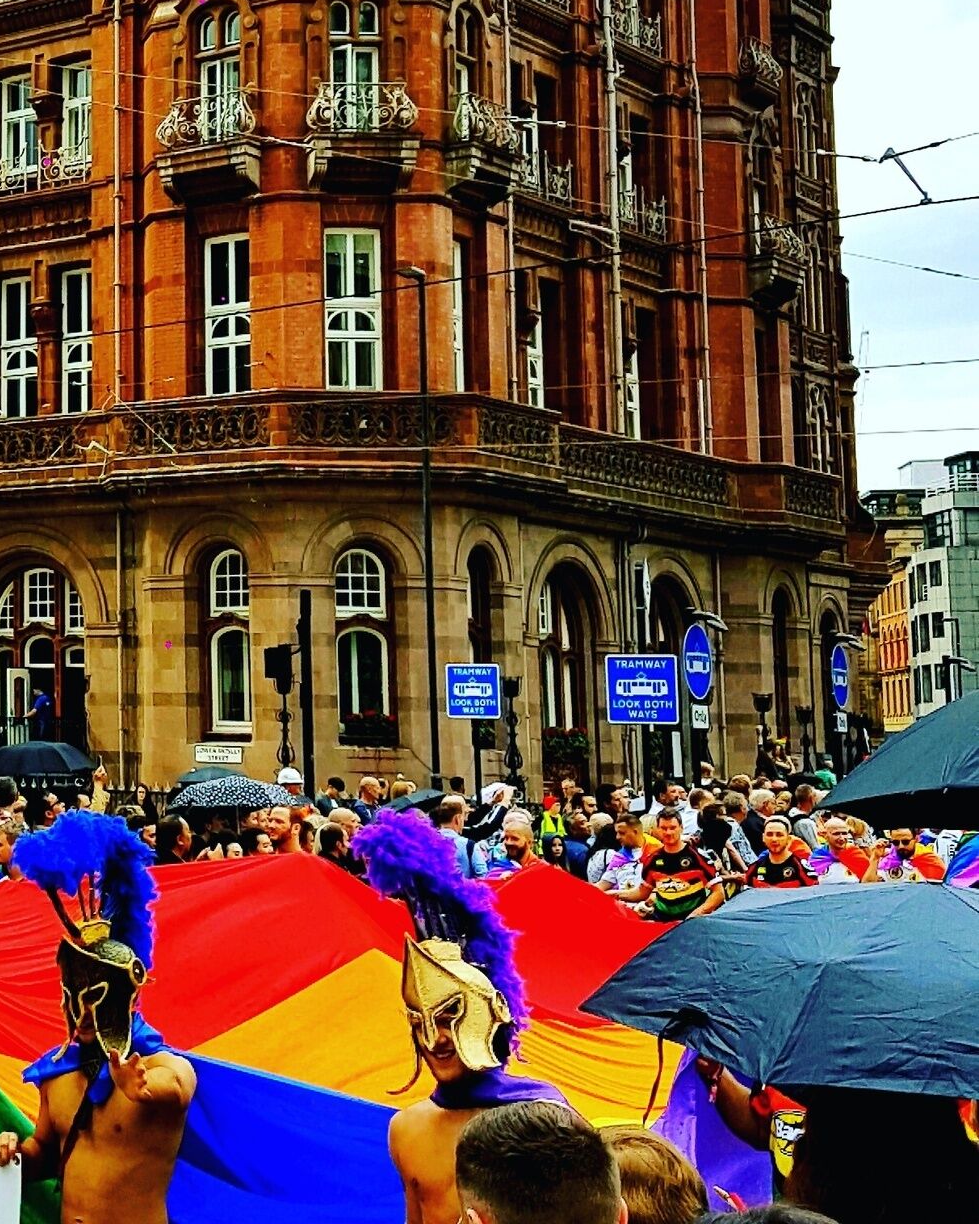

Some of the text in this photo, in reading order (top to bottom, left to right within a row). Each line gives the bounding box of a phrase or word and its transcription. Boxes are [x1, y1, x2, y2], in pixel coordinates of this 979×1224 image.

[614, 659, 667, 669] TRAMWAY
[453, 668, 492, 676] TRAMWAY
[450, 698, 497, 707] LOOK BOTH
[612, 699, 673, 709] LOOK BOTH
[462, 707, 485, 715] WAYS
[628, 709, 658, 720] WAYS
